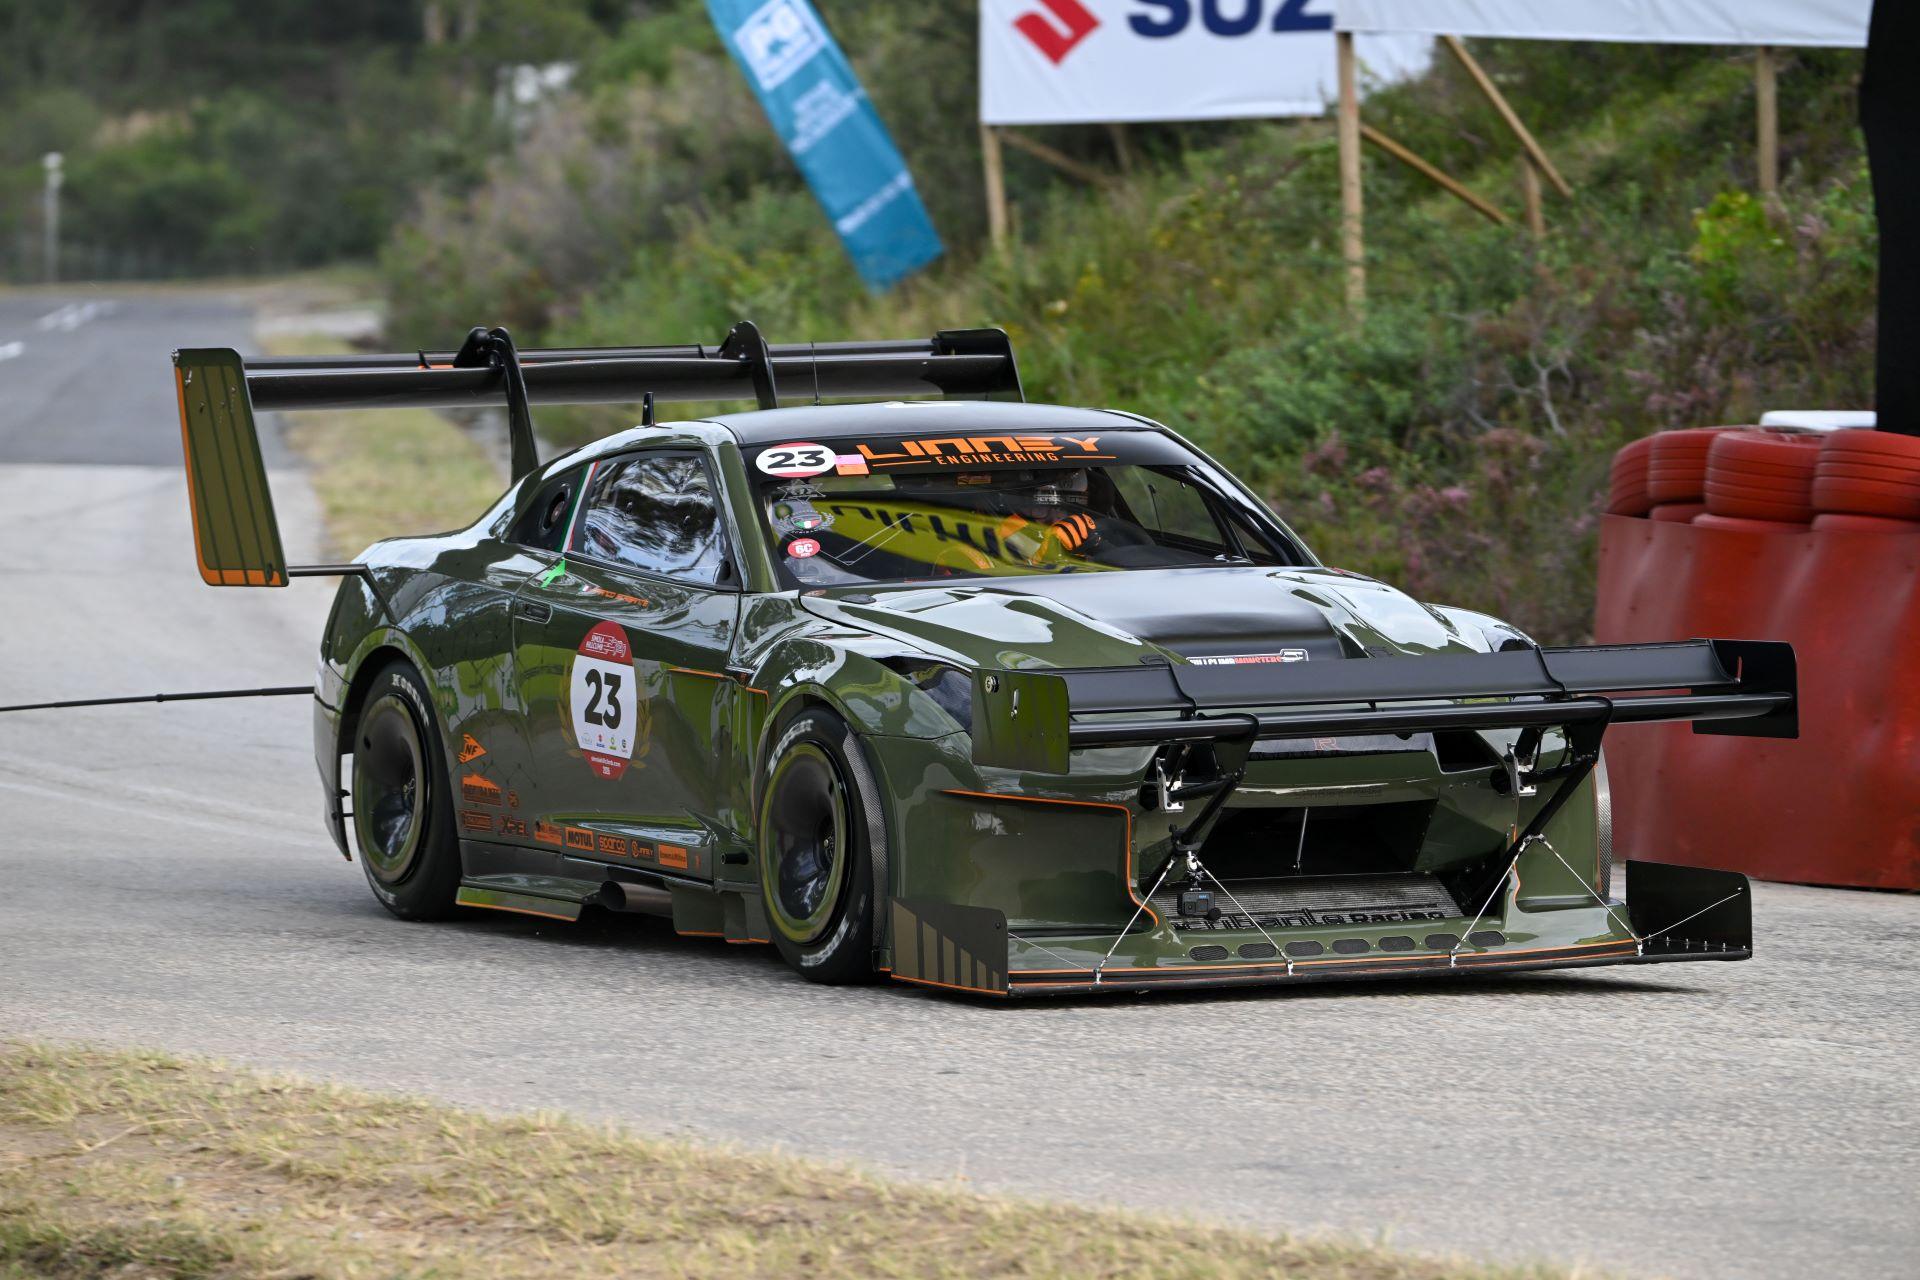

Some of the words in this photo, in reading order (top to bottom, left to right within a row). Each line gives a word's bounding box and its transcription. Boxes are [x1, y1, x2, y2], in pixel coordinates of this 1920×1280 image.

[856, 436, 1101, 460] LINNEY
[768, 450, 826, 469] 23
[937, 451, 1060, 466] ENGINEERING
[584, 668, 622, 730] 23
[567, 830, 593, 847] MOTUL
[599, 836, 626, 851] sparco
